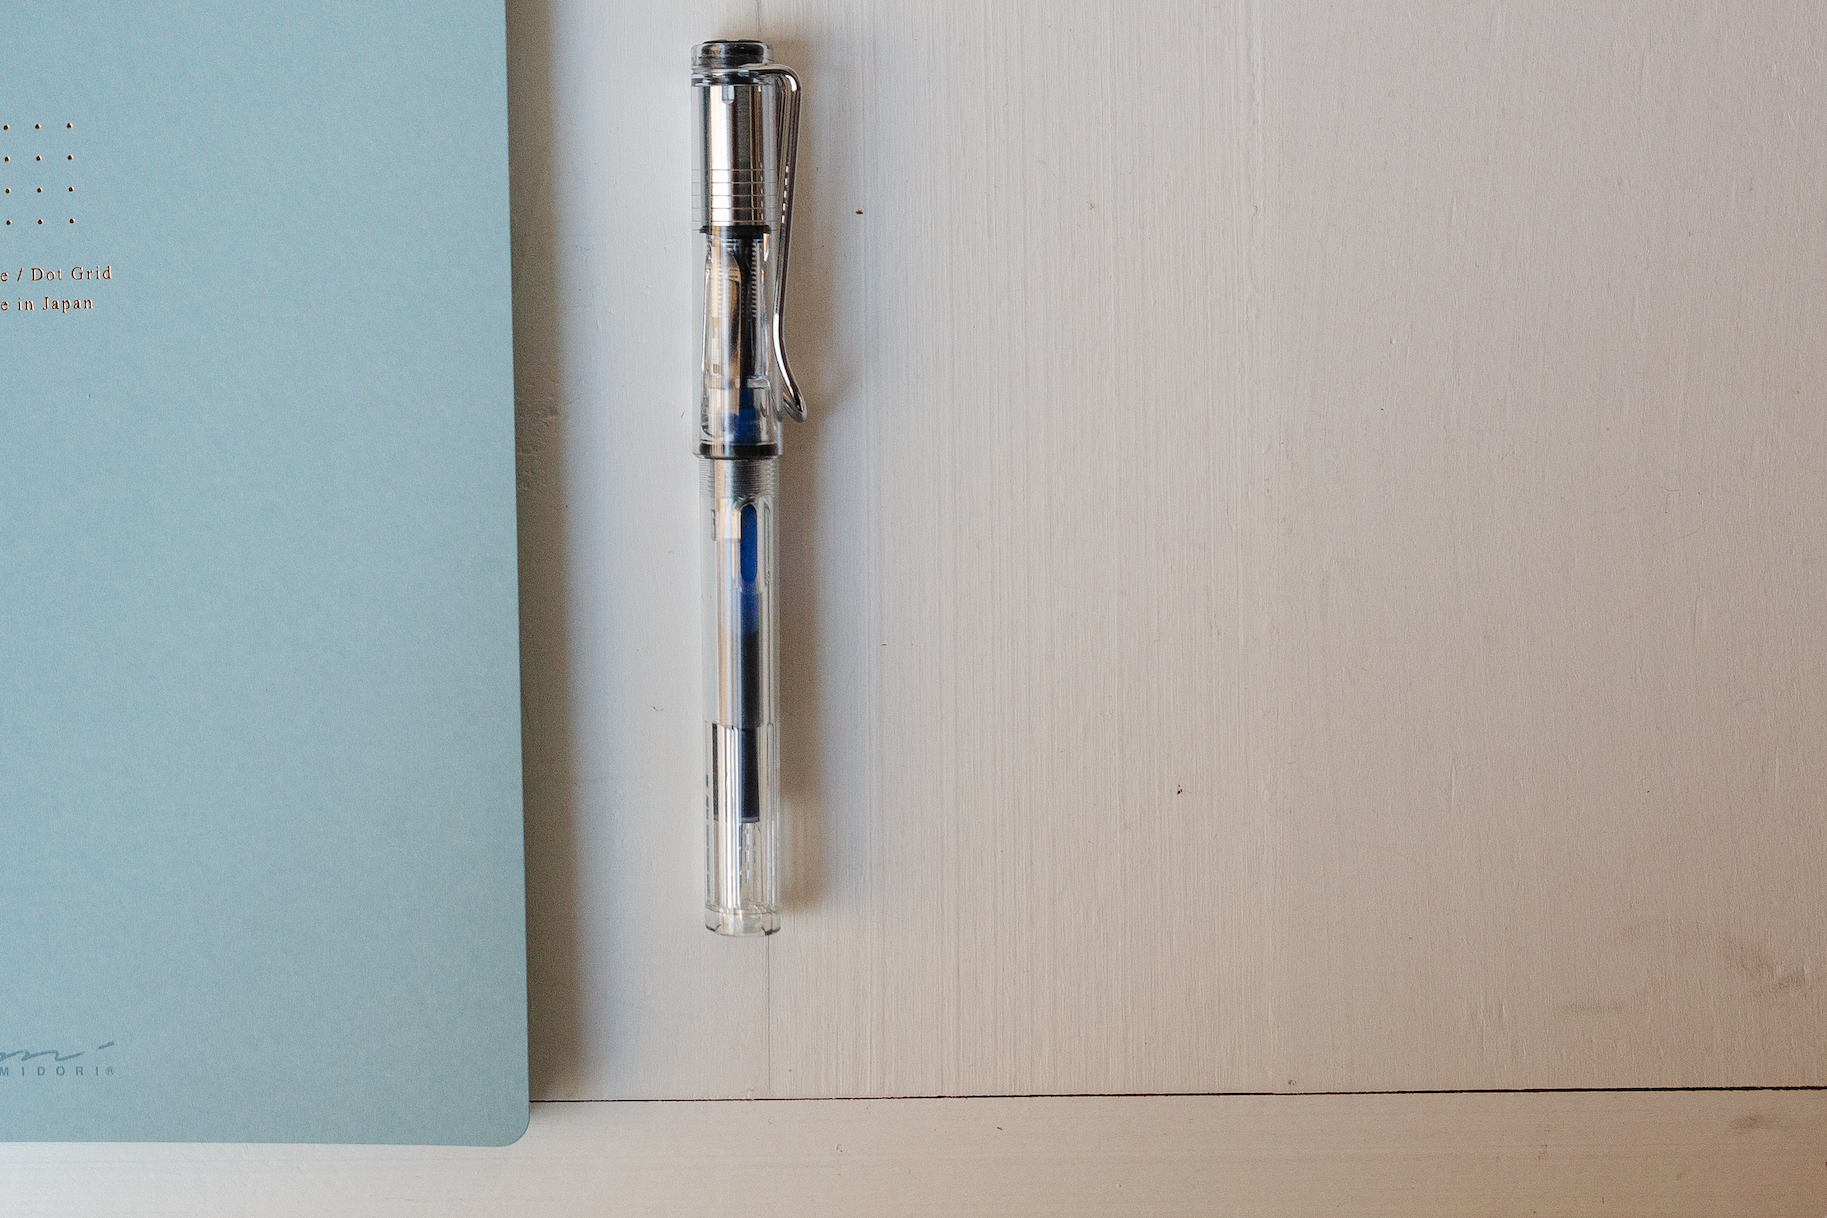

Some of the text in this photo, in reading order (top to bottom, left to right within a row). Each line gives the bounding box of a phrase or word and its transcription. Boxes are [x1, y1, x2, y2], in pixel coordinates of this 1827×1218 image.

[31, 267, 64, 281] Dot
[71, 265, 113, 280] Grid
[18, 297, 35, 311] in
[42, 297, 94, 313] Japan
